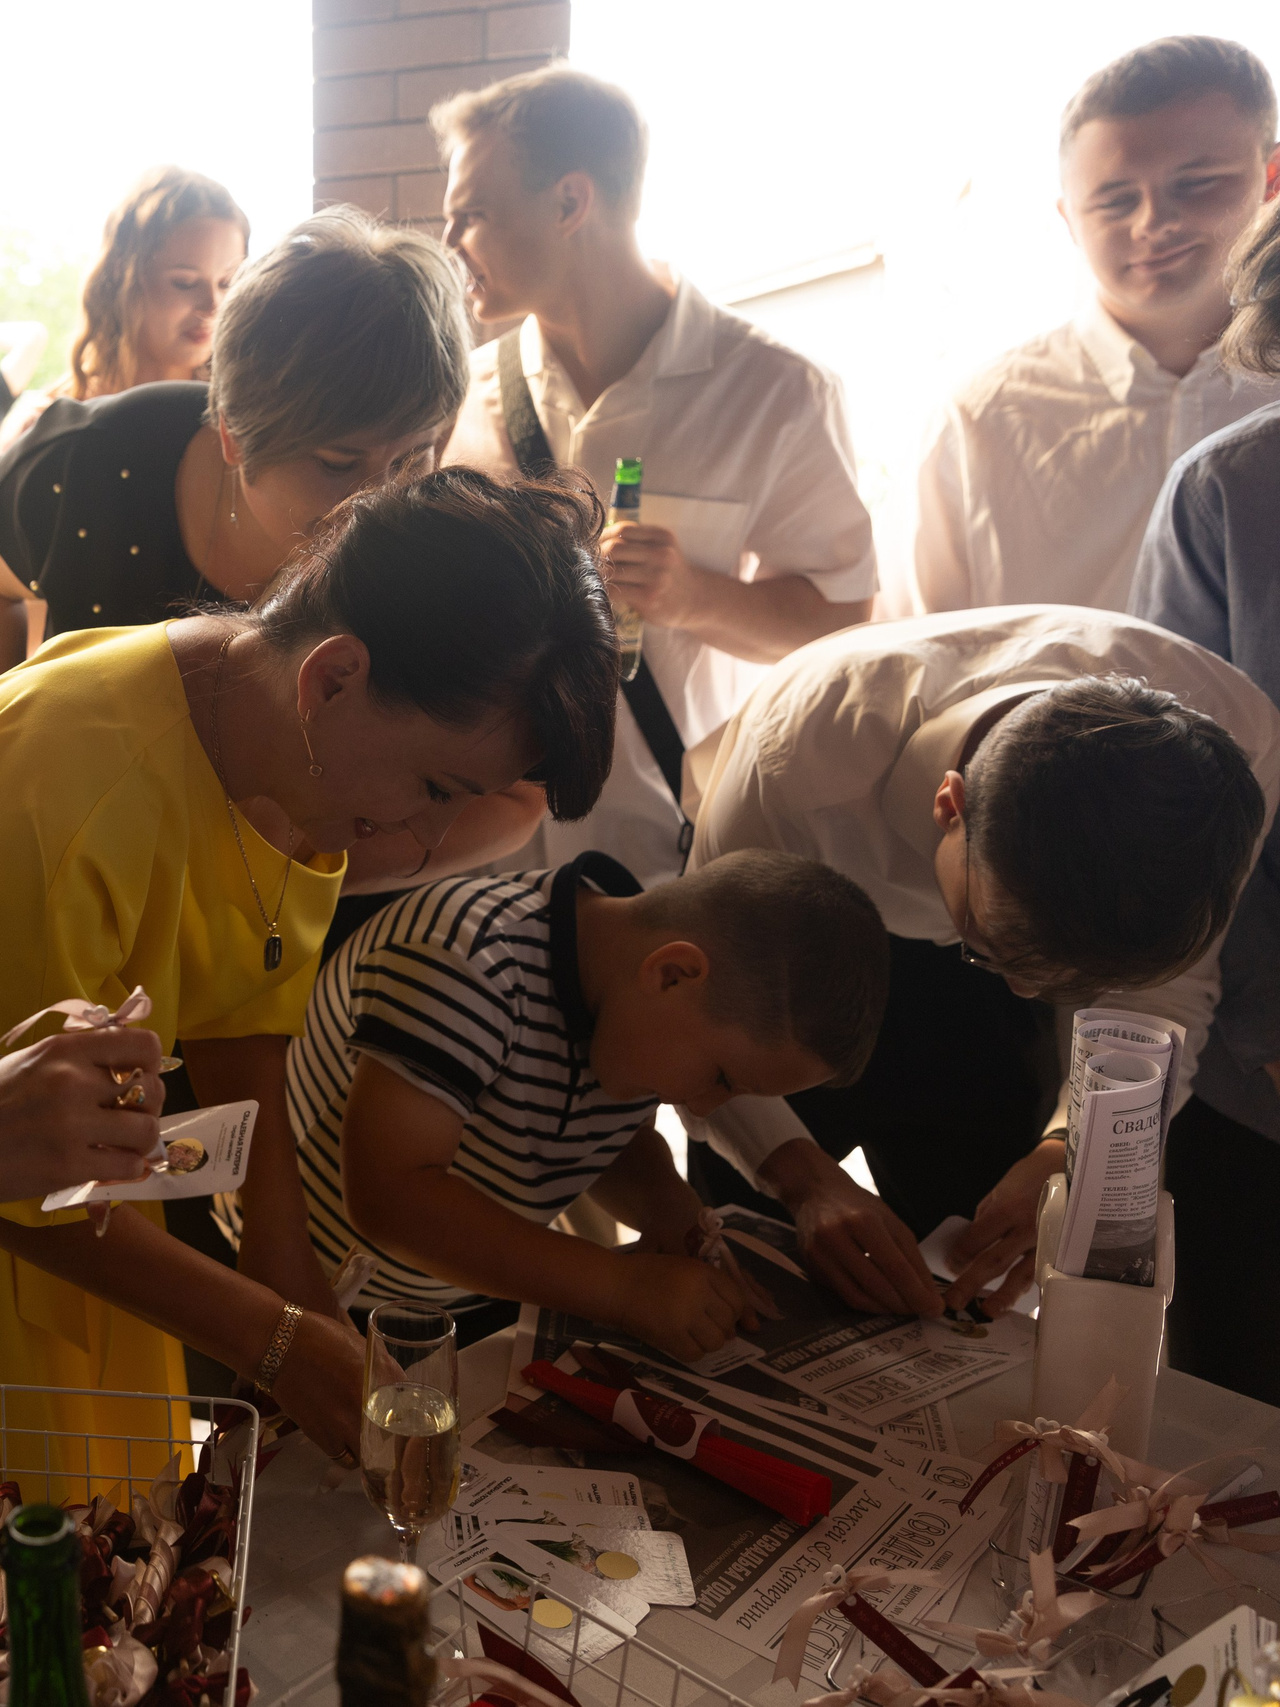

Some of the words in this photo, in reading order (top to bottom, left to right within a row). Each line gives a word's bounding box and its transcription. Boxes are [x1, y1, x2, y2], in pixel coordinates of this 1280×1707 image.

[827, 1373, 914, 1410] ВЕСТИ
[824, 1489, 882, 1543] Алексей
[723, 1532, 782, 1582] СВАДЬБА
[694, 1574, 737, 1613] ГОДА!
[735, 1553, 821, 1631] Екатерина
